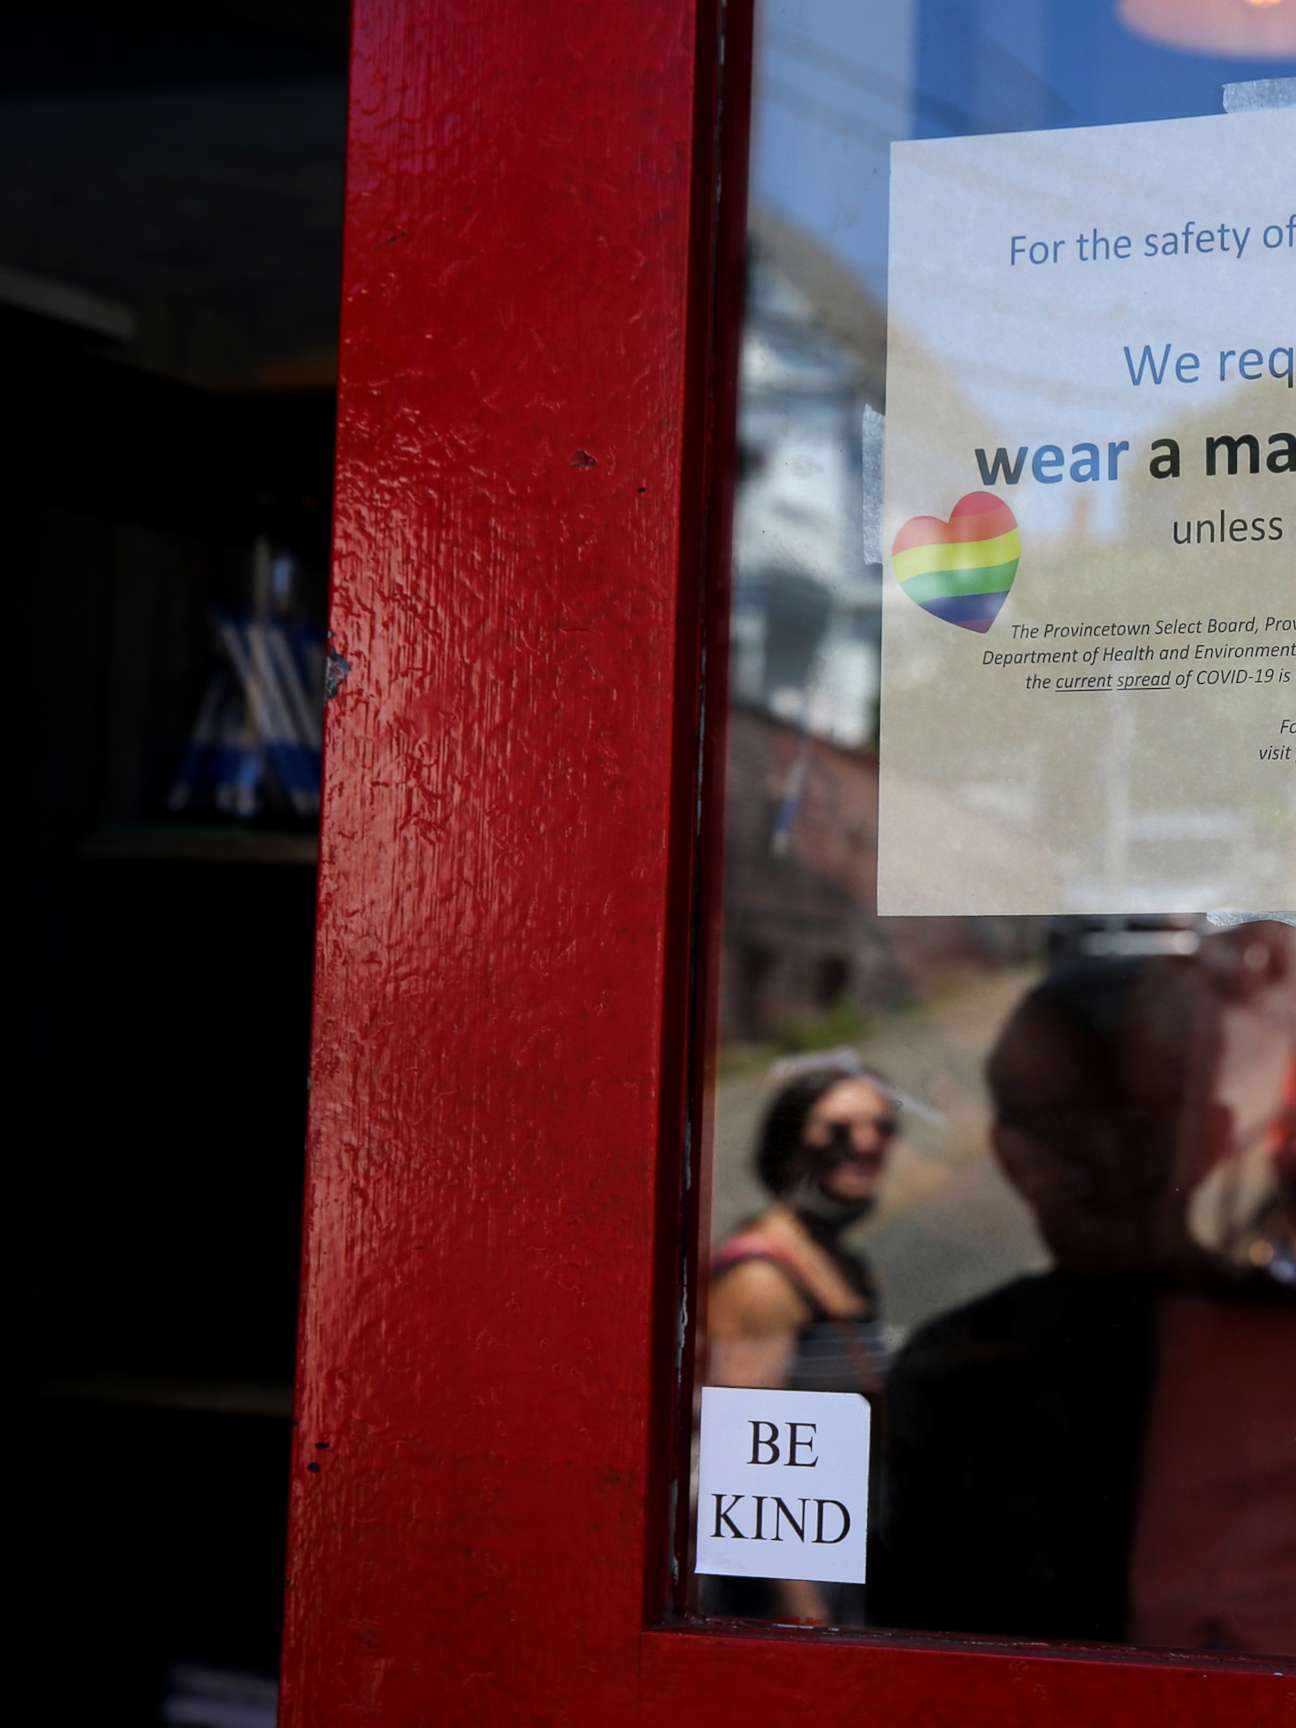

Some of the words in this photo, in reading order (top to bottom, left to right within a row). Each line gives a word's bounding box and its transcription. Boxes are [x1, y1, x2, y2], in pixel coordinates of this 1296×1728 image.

[1011, 236, 1065, 266] For
[1076, 228, 1131, 261] the
[1144, 221, 1250, 258] safety
[1124, 344, 1200, 386] We
[975, 441, 1129, 486] wear
[1150, 439, 1180, 479] a
[1174, 510, 1282, 544] unless
[1012, 624, 1039, 639] The
[1044, 623, 1150, 637] Provincetown
[1155, 619, 1202, 635] Select
[1208, 617, 1258, 634] Board,
[983, 650, 1078, 667] Department
[1083, 647, 1100, 665] of
[1103, 645, 1154, 661] Health
[1160, 645, 1189, 660] and
[1195, 643, 1296, 659] Environment
[1026, 674, 1051, 689] the
[1056, 674, 1113, 692] current
[1117, 671, 1171, 690] spread
[1176, 671, 1192, 688] of
[1197, 668, 1274, 684] COVID-19
[1279, 668, 1290, 682] is
[1259, 746, 1292, 760] visit
[747, 1421, 818, 1467] BE
[711, 1494, 850, 1543] KIND
